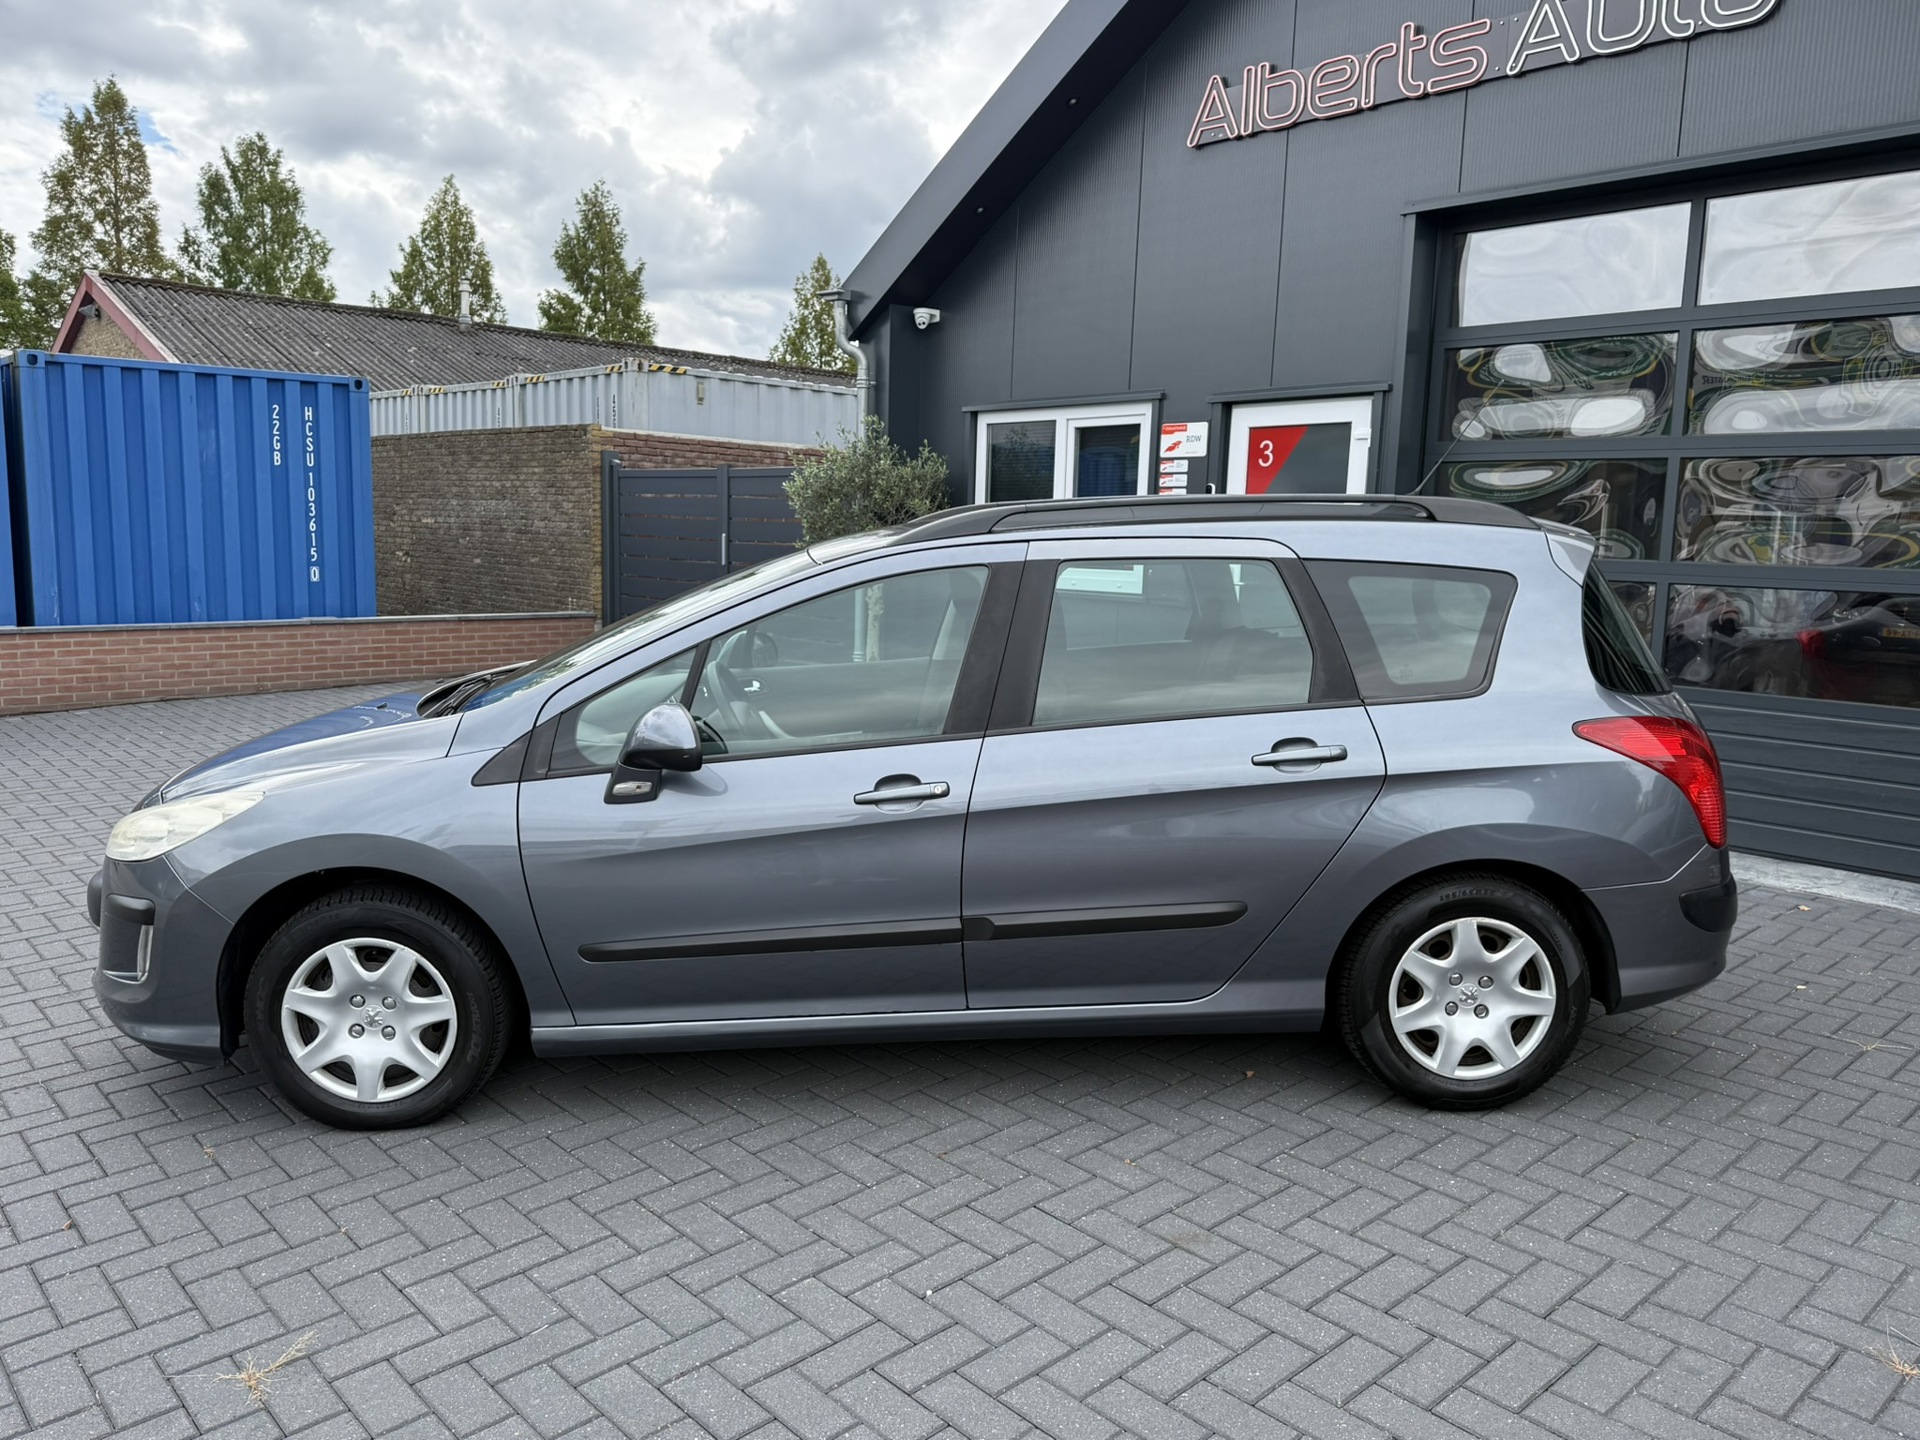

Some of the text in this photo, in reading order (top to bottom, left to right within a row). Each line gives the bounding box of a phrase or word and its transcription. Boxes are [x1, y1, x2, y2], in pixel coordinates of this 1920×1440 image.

[1186, 18, 1492, 148] Alberts
[272, 404, 281, 466] 22GB
[304, 406, 314, 467] HCSU
[1186, 435, 1202, 443] RDW
[1258, 439, 1274, 467] 3
